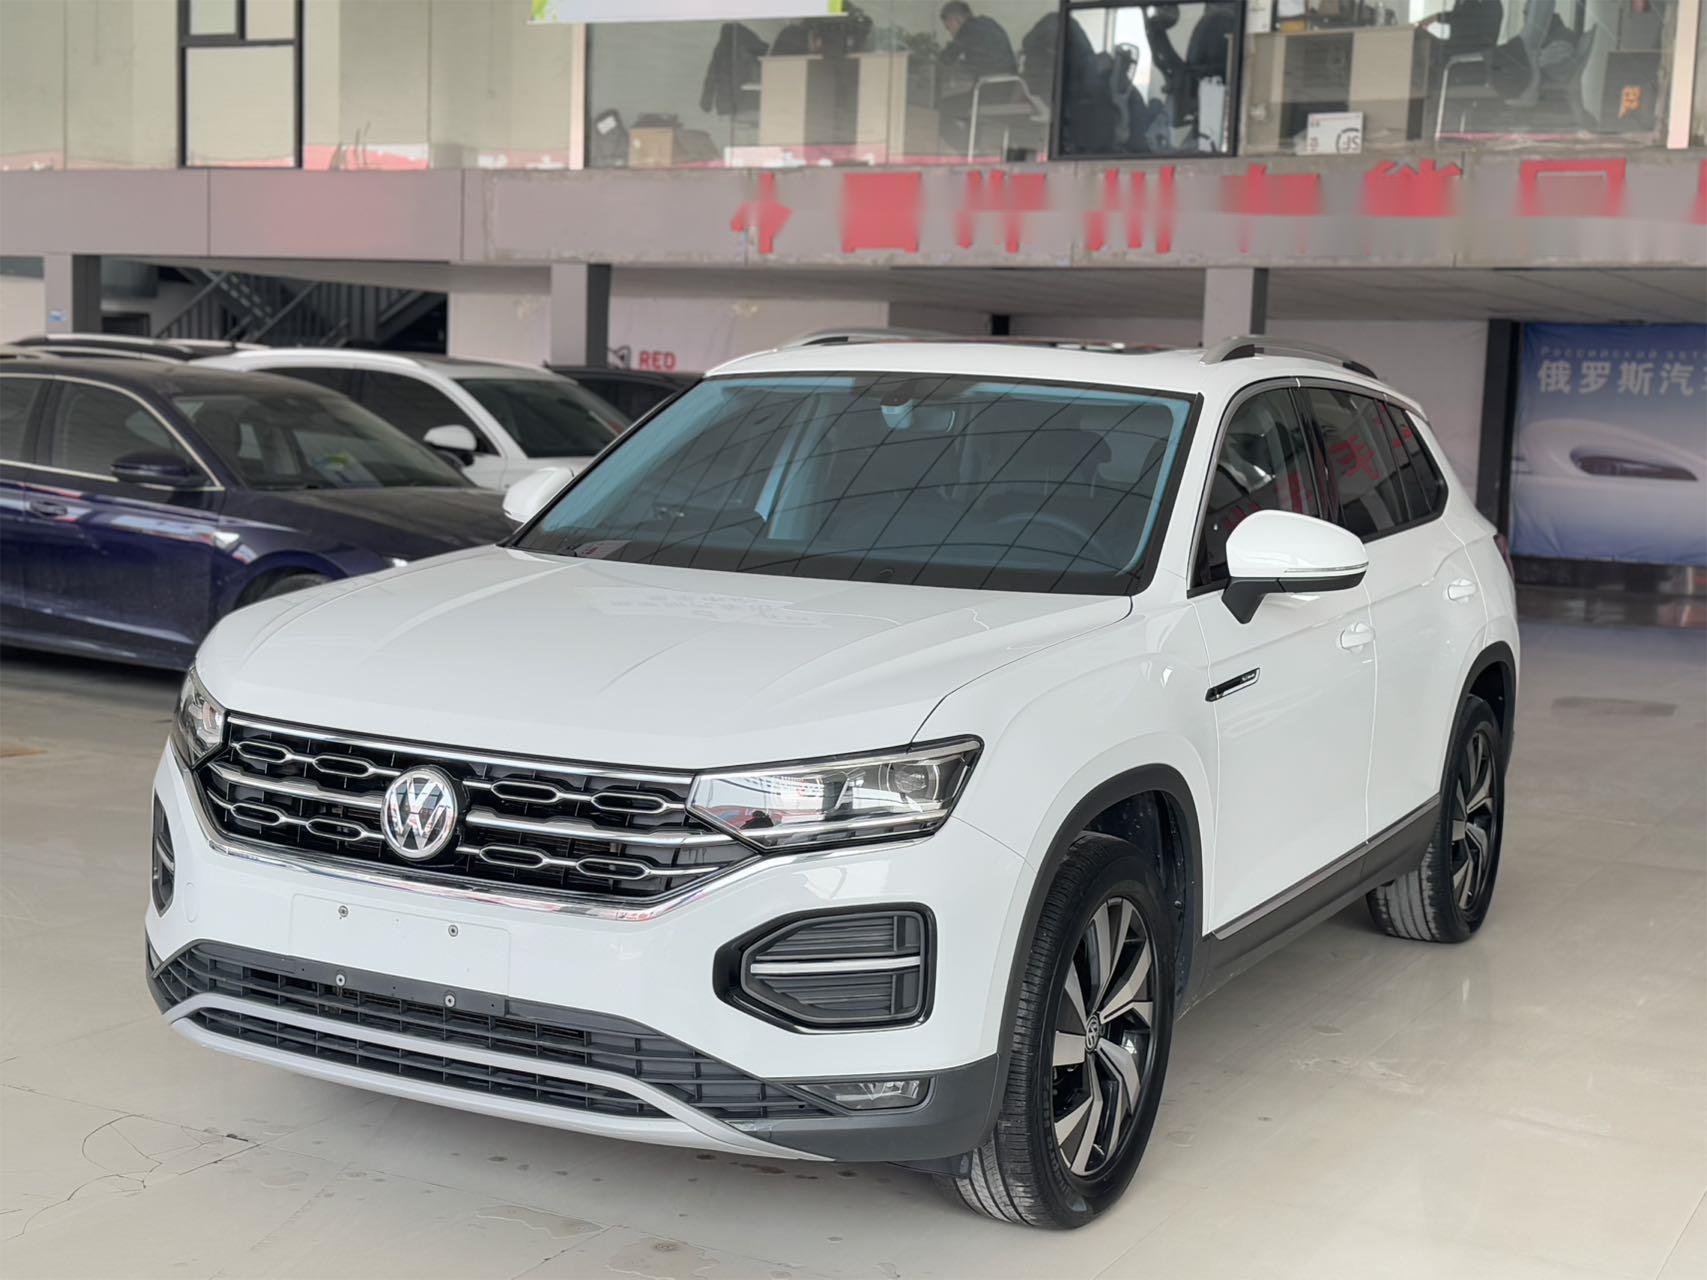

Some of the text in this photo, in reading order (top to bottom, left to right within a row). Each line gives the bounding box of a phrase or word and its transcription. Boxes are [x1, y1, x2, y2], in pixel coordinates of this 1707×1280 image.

[1538, 360, 1707, 396] 俄罗斯汽
[384, 769, 457, 858] VW
